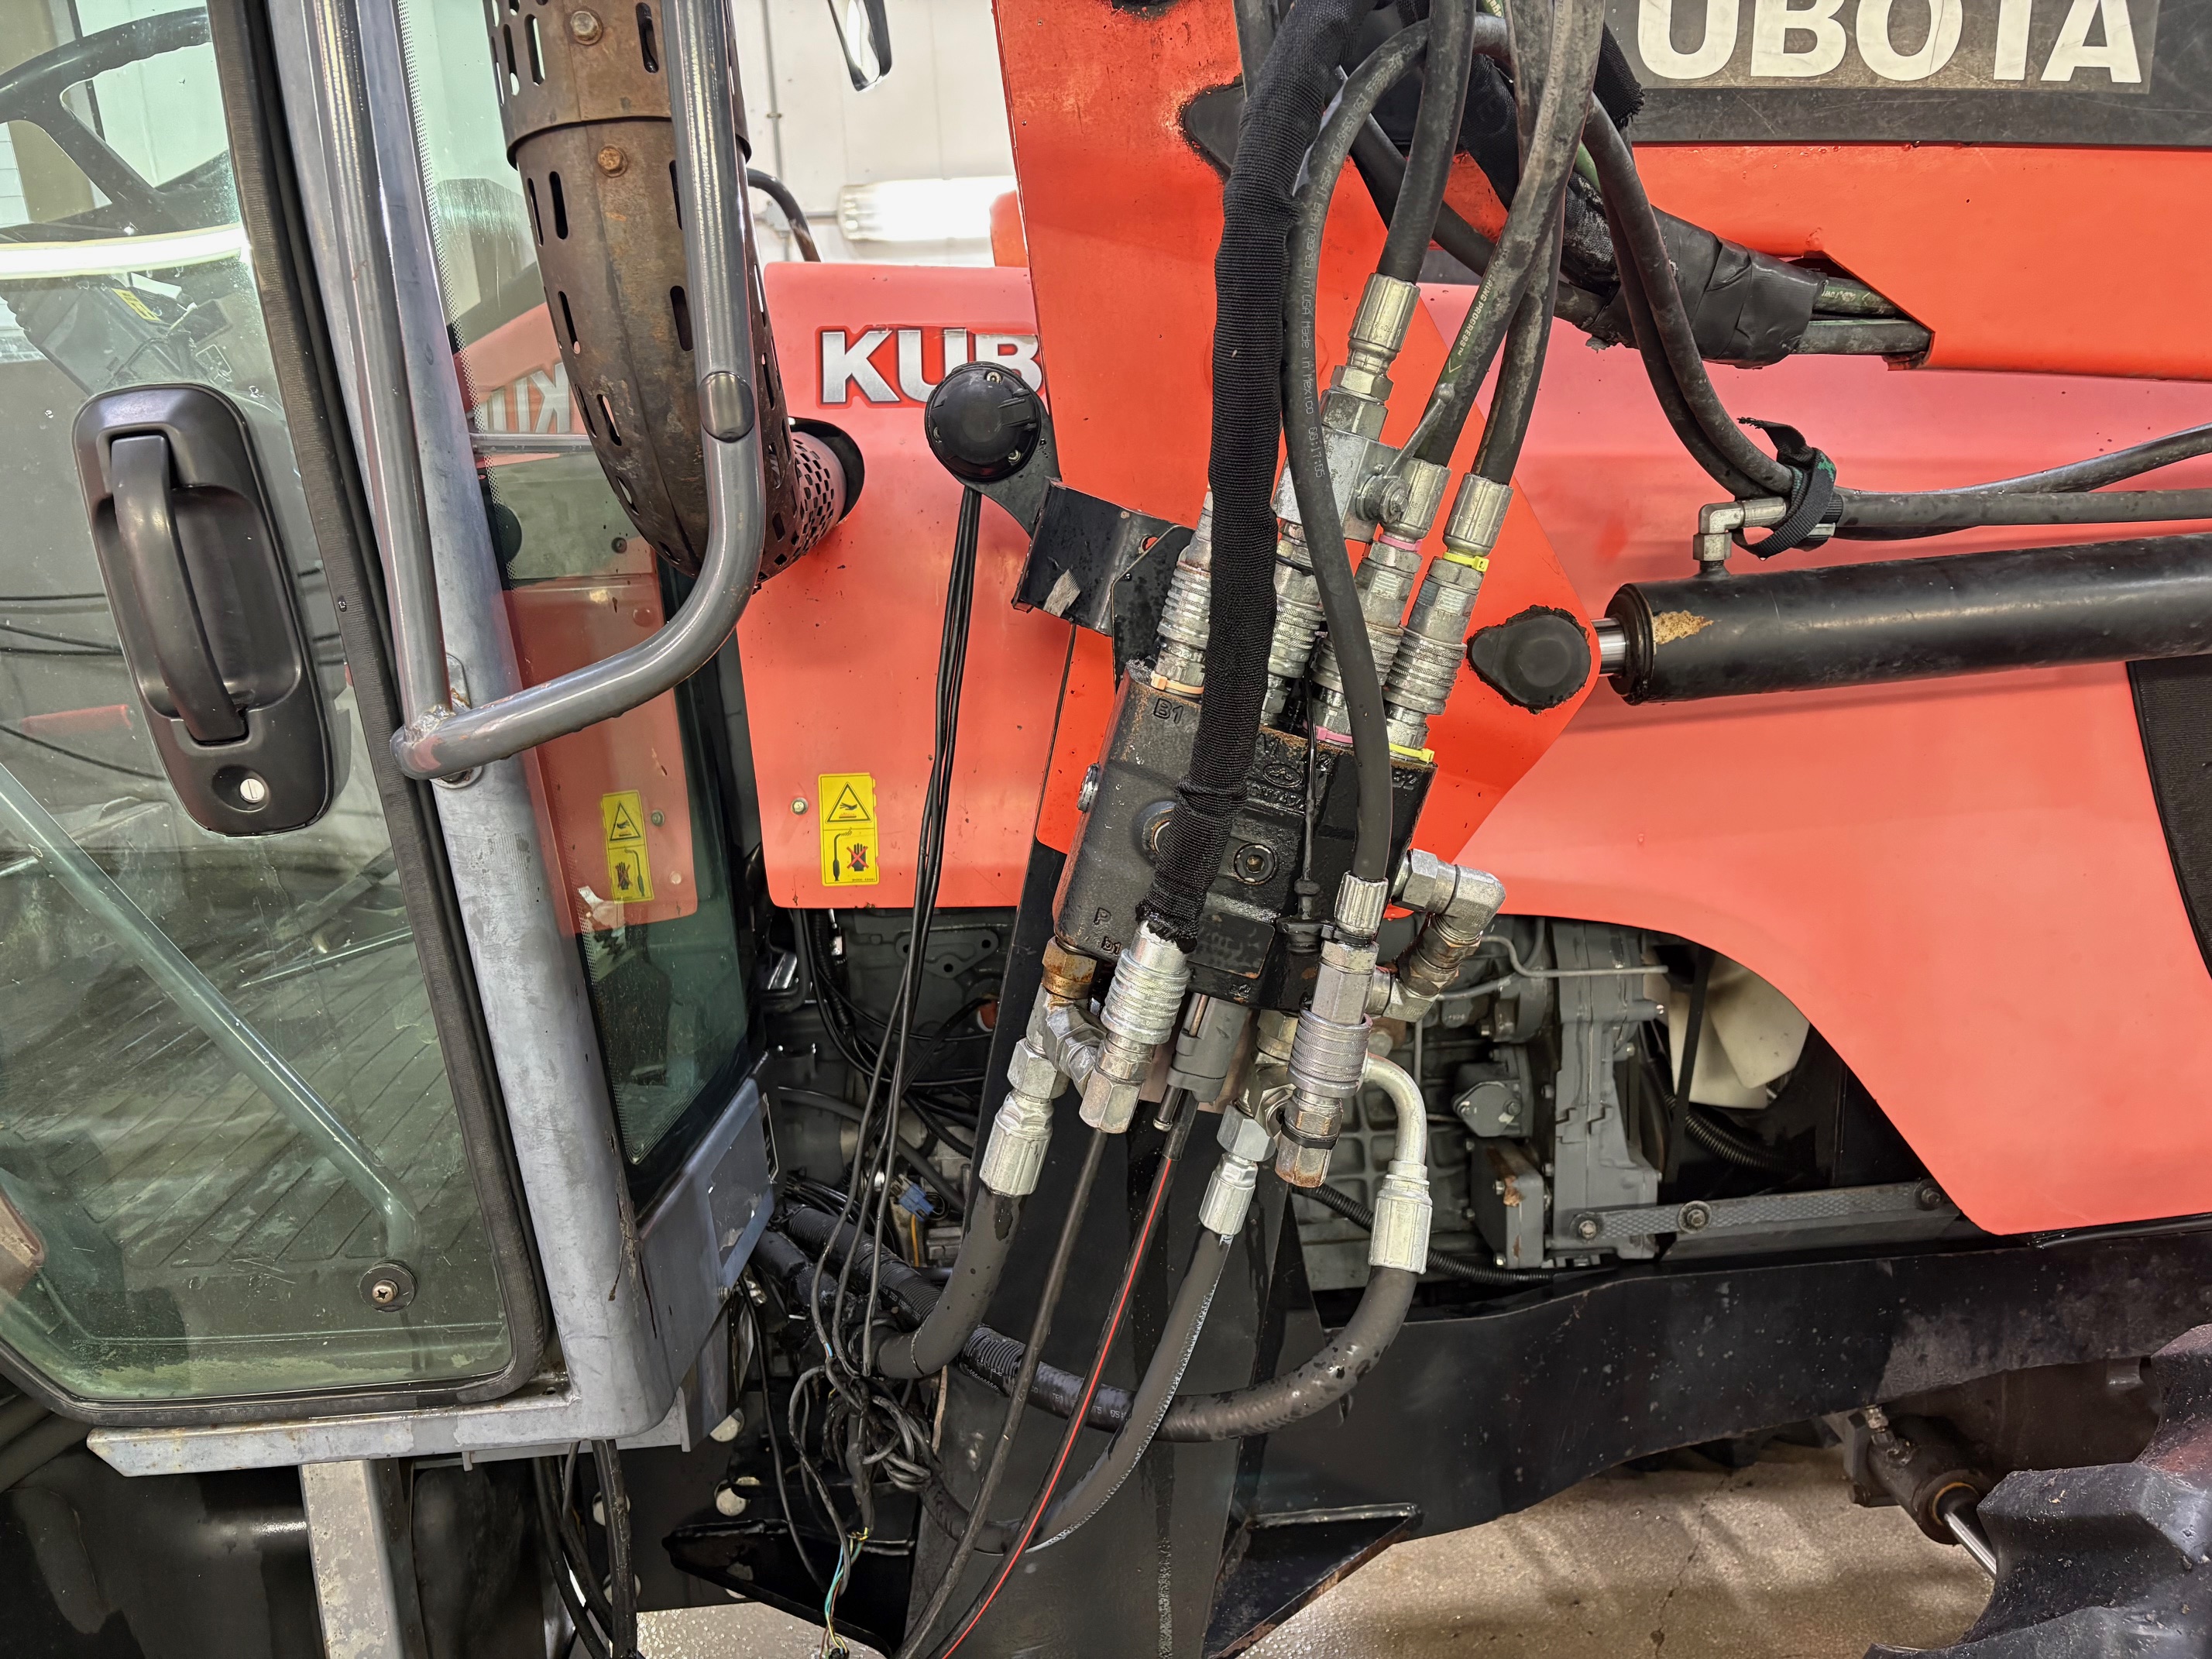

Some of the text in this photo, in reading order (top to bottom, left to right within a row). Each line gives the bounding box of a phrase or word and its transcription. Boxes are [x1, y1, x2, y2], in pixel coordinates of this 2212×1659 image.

[1304, 202, 1323, 269] Engineered
[1303, 276, 1311, 288] in
[1302, 294, 1312, 315] USA
[1301, 321, 1310, 349] Made
[1302, 357, 1310, 371] in
[1303, 373, 1314, 414] Mexico
[1153, 698, 1183, 724] B1
[1094, 907, 1111, 926] P
[1101, 936, 1121, 955] b1
